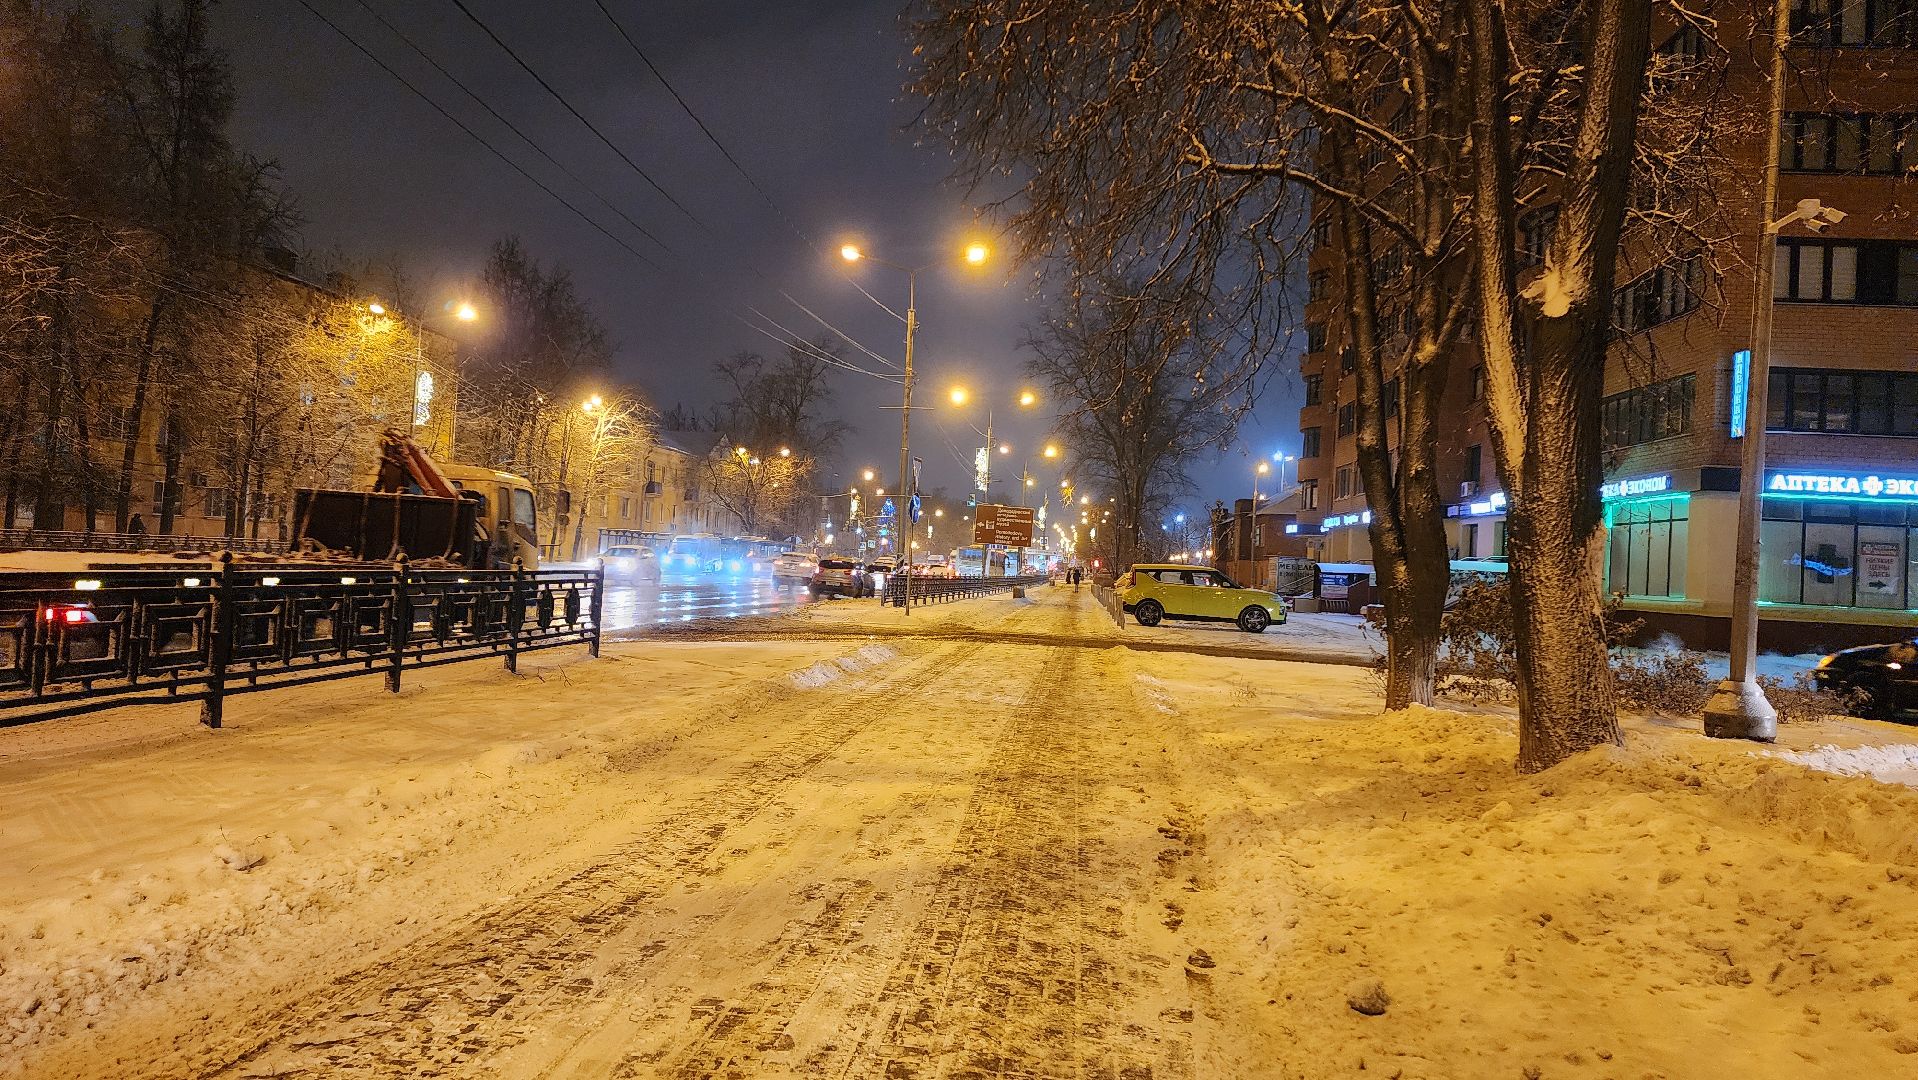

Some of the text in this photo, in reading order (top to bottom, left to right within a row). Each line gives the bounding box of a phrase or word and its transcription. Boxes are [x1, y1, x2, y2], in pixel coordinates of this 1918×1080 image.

[1627, 476, 1667, 495] ЭКОНОМ
[1771, 474, 1918, 495] АПТЕКА ЭК
